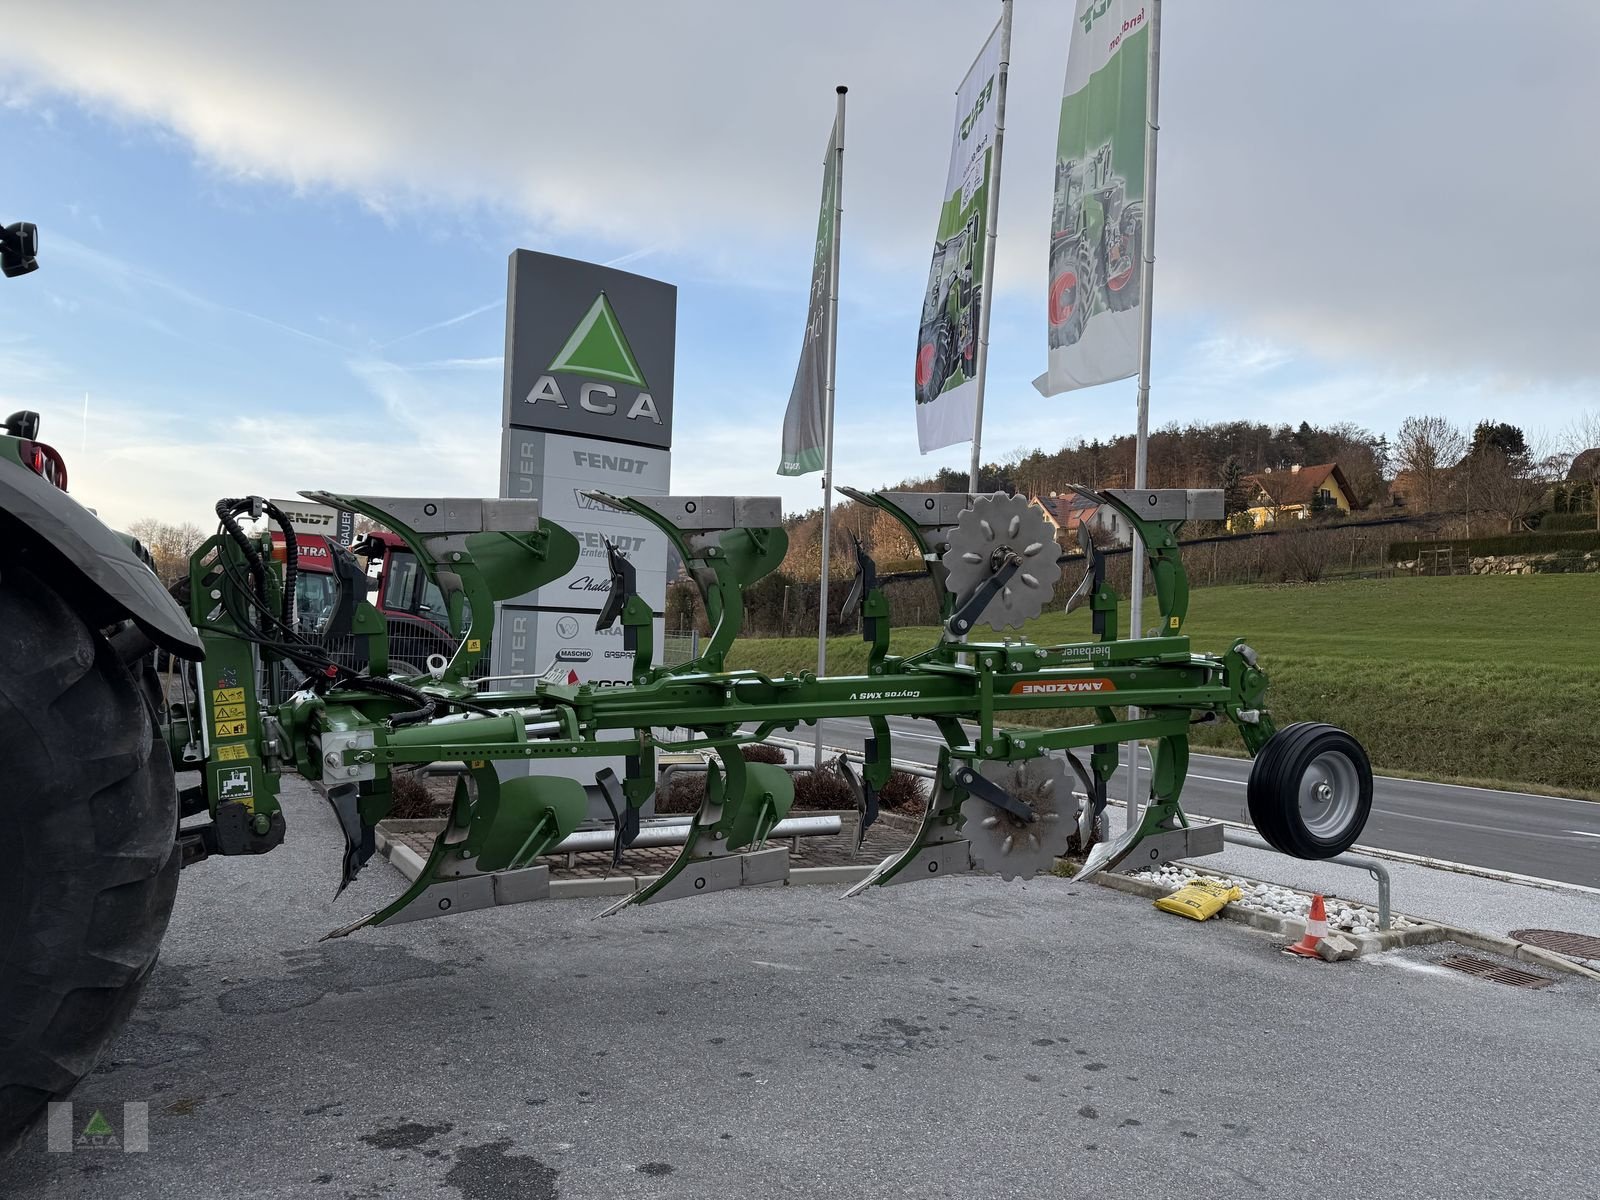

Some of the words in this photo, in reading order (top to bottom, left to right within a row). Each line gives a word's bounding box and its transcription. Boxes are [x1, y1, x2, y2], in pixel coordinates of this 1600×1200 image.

[524, 375, 664, 425] ACA
[519, 442, 534, 494] UER
[572, 450, 649, 475] FENDT
[285, 511, 334, 526] ENDT
[297, 546, 327, 557] LTRA
[568, 576, 612, 592] Challe
[511, 617, 526, 687] NTER
[604, 650, 636, 659] GASPAR
[1062, 646, 1111, 661] bierbauer
[884, 689, 921, 698] Cayros
[1022, 682, 1103, 694] AMAZONE
[859, 692, 883, 700] XMS
